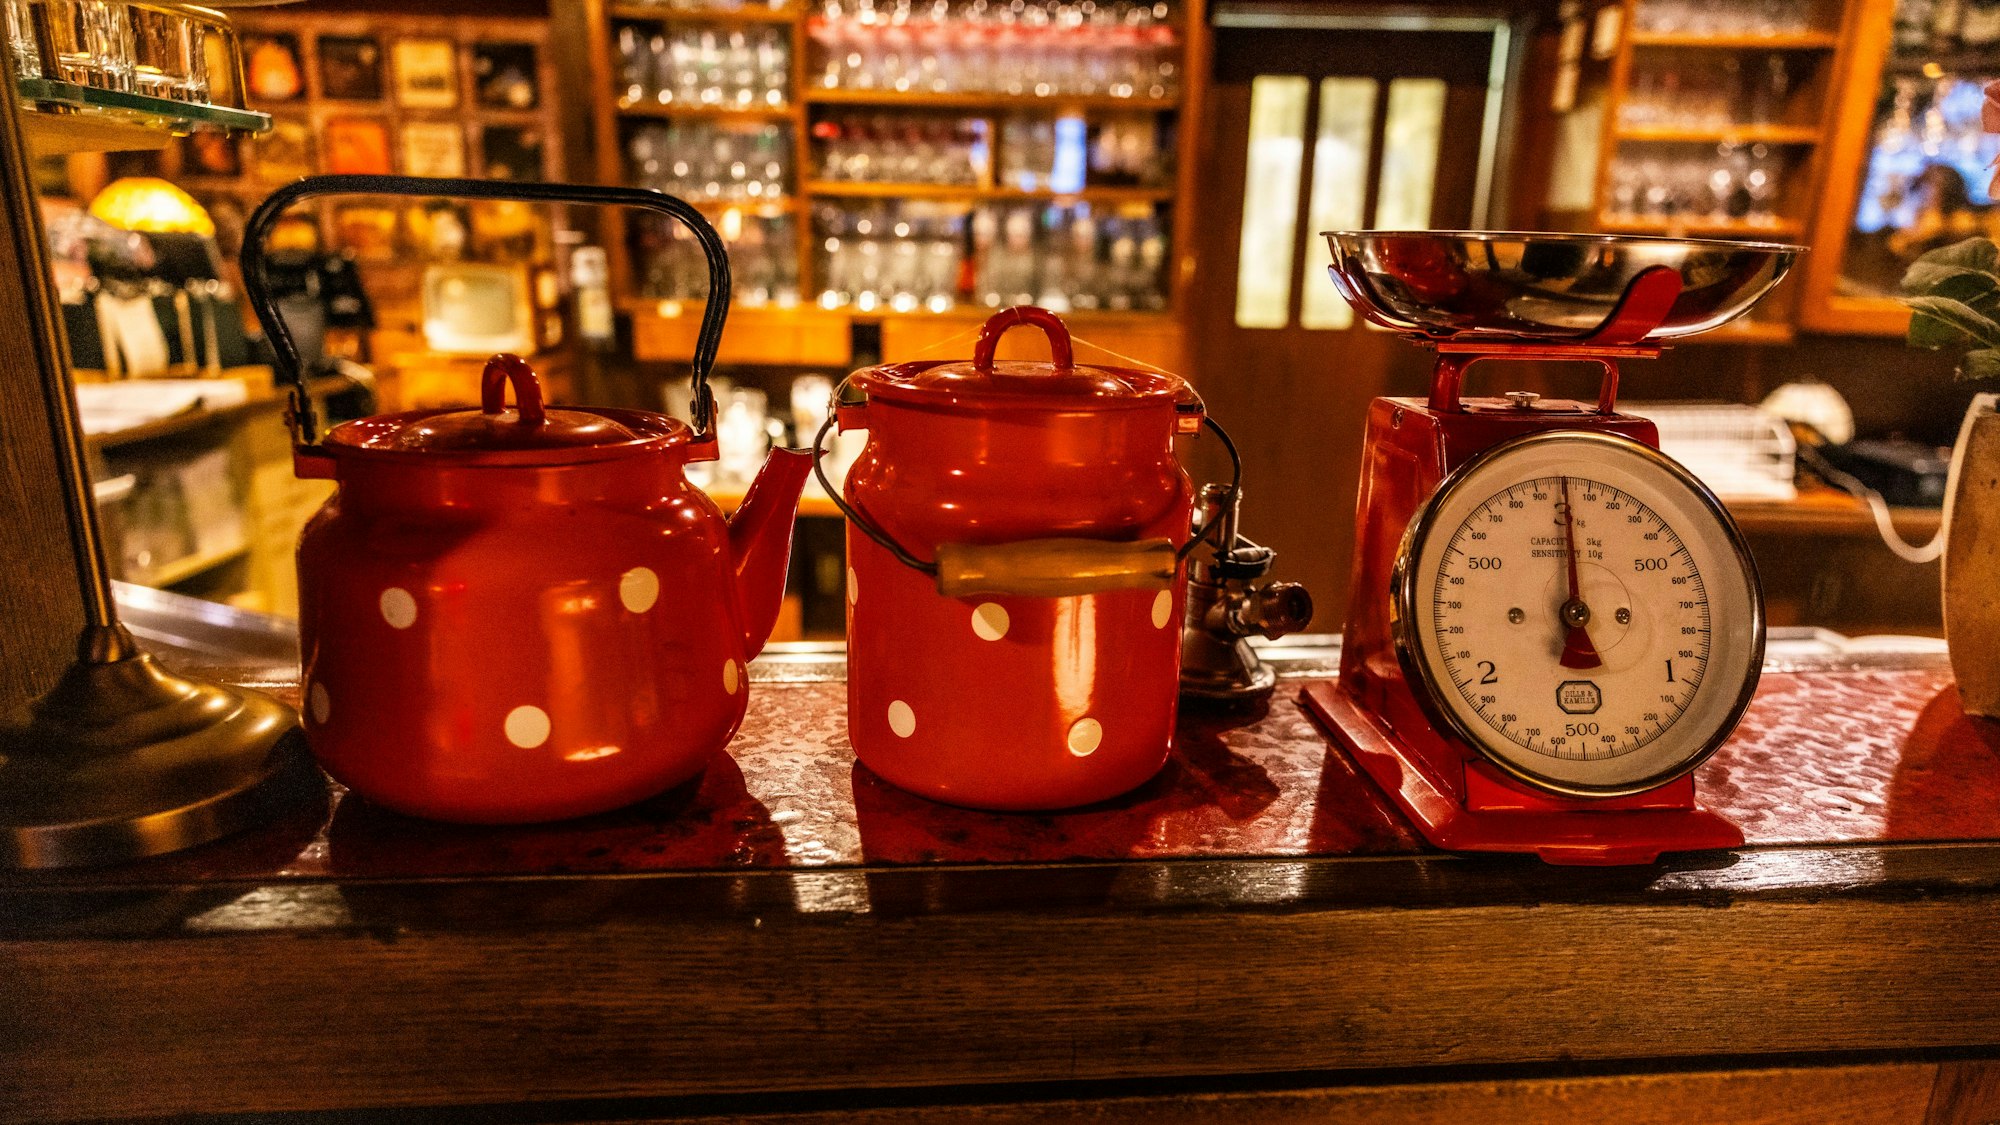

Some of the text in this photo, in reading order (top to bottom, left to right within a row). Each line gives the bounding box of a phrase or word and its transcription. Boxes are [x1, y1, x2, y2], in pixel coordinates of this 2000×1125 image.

[1533, 493, 1548, 501] 900
[1583, 494, 1597, 502] 100
[1509, 501, 1524, 509] 800
[1606, 502, 1621, 510] 200
[1489, 515, 1503, 523] 700
[1577, 518, 1586, 528] kg
[1628, 516, 1642, 524] 300
[1472, 533, 1487, 541] 600
[1644, 533, 1659, 541] 400
[1530, 537, 1602, 547] CAPACIT 3kg
[1588, 550, 1603, 560] 10g
[1468, 557, 1502, 570] 500
[1635, 558, 1668, 572] 500
[1672, 577, 1687, 585] 600
[1448, 601, 1462, 610] 300
[1450, 626, 1464, 634] 200
[1682, 627, 1696, 635] 800
[1457, 651, 1471, 659] 100
[1477, 661, 1498, 685] 2
[1665, 659, 1675, 682] 1
[1481, 696, 1496, 704] 900
[1661, 695, 1675, 704] 100
[1502, 714, 1517, 723] 800
[1644, 713, 1658, 721] 200
[1526, 729, 1541, 737] 700
[1566, 723, 1600, 737] 500
[1625, 727, 1640, 735] 300
[1551, 737, 1566, 745] 600
[1601, 735, 1616, 743] 400
